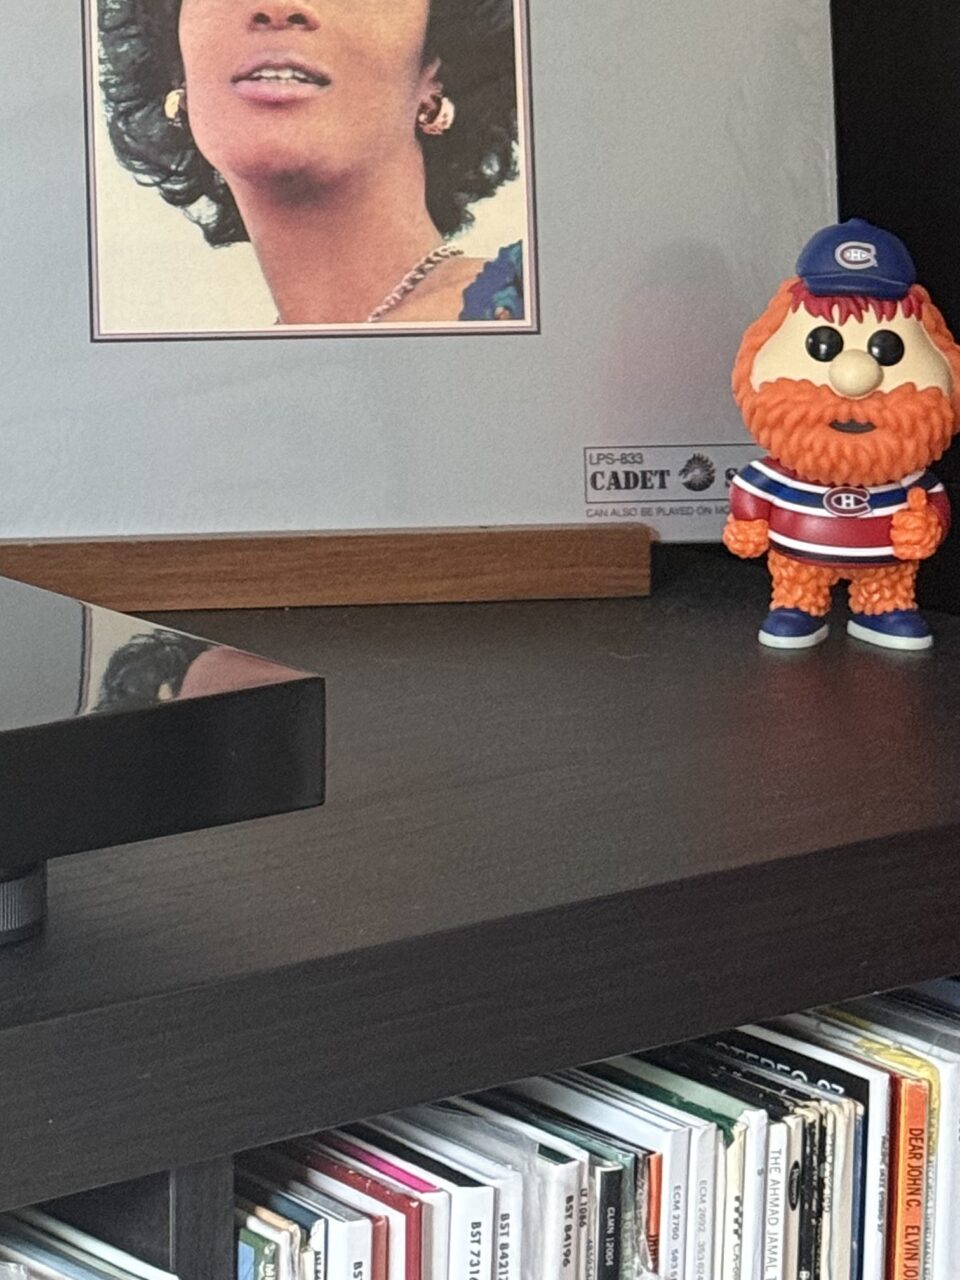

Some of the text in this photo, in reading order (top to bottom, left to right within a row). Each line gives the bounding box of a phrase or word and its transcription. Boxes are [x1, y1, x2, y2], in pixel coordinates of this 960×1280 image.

[590, 469, 671, 491] CADET
[610, 507, 638, 518] ALSO
[641, 506, 654, 517] BE
[656, 505, 695, 516] PLAYED
[696, 505, 712, 516] ON
[770, 1148, 782, 1174] THE
[672, 1185, 682, 1211] ECM
[698, 1180, 708, 1204] ECM
[768, 1179, 781, 1227] AHMAD
[903, 1127, 925, 1280] DEAR JOHN C. ELVIN JO
[565, 1194, 574, 1220] BST
[470, 1221, 482, 1245] BST
[499, 1213, 510, 1237] BST
[605, 1207, 616, 1267] CLMN 12004
[766, 1231, 778, 1272] JAMAL
